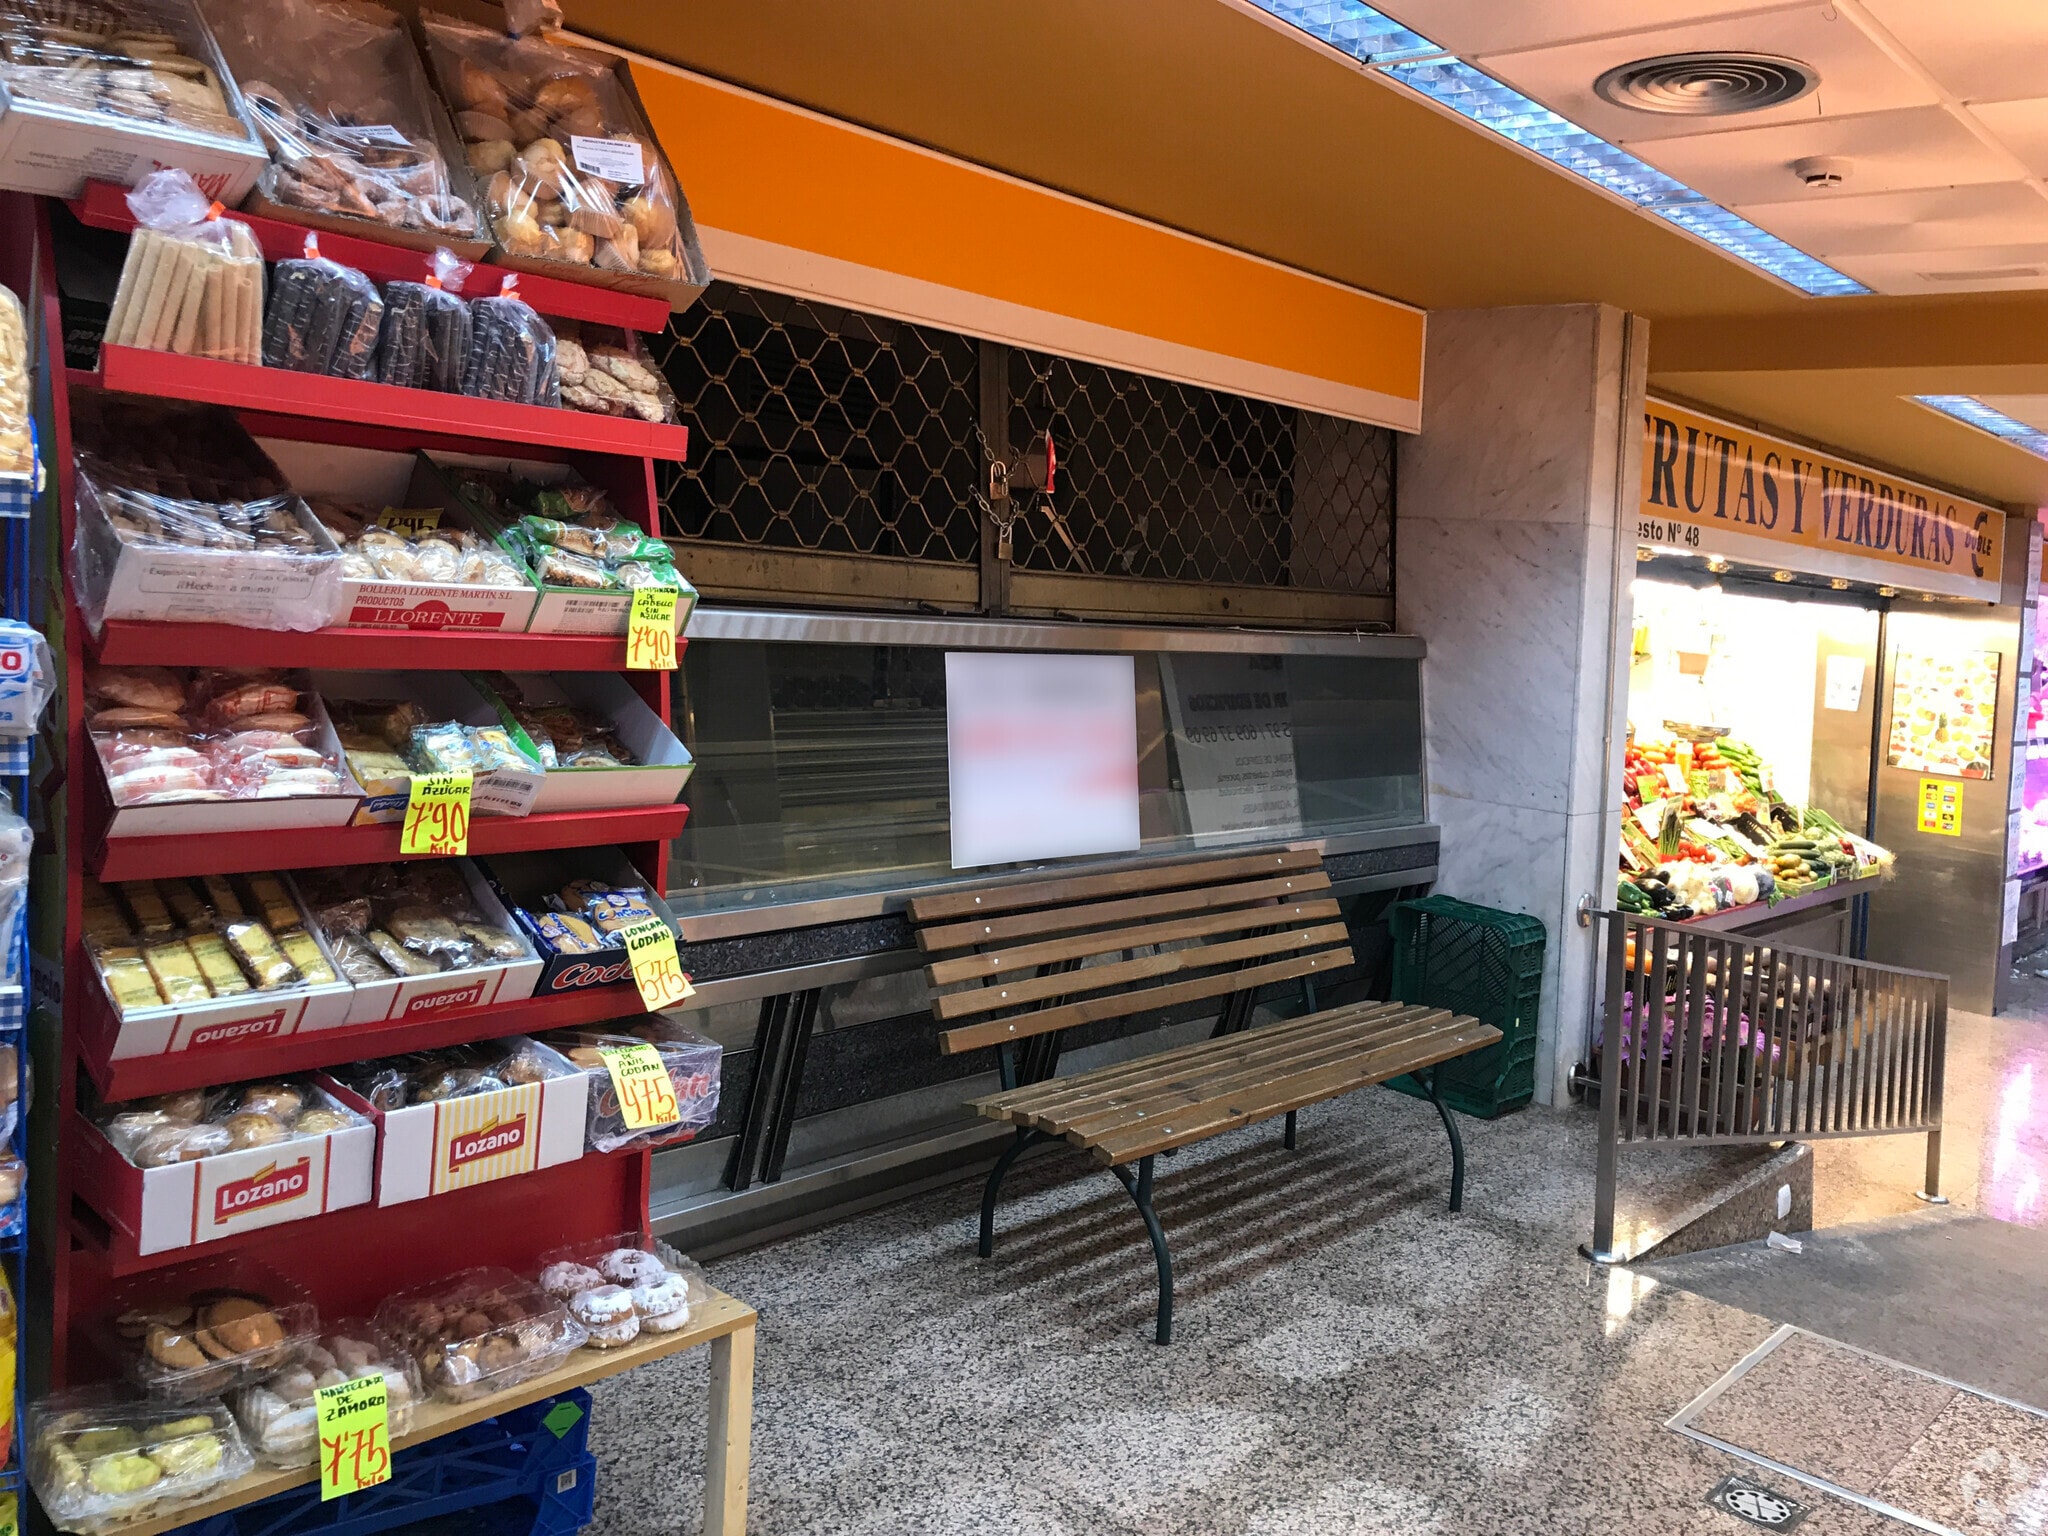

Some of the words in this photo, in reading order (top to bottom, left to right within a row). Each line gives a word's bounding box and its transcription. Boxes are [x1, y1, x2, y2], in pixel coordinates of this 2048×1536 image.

[1791, 458, 1812, 534] Y
[1821, 466, 1957, 566] VERDURAS
[1685, 526, 1699, 547] 48
[355, 596, 405, 606] PRODUCTOS
[408, 587, 459, 598] LLORENTE
[374, 609, 484, 625] LLORENTE
[0, 651, 22, 671] O
[428, 778, 453, 786] SIN
[630, 929, 670, 951] CODAN
[412, 989, 478, 1011] Lozano
[196, 1019, 277, 1043] Lozano
[621, 1063, 659, 1077] CODAN
[455, 1128, 521, 1160] Lozano
[222, 1174, 303, 1210] Lozano
[336, 1394, 354, 1406] DE
